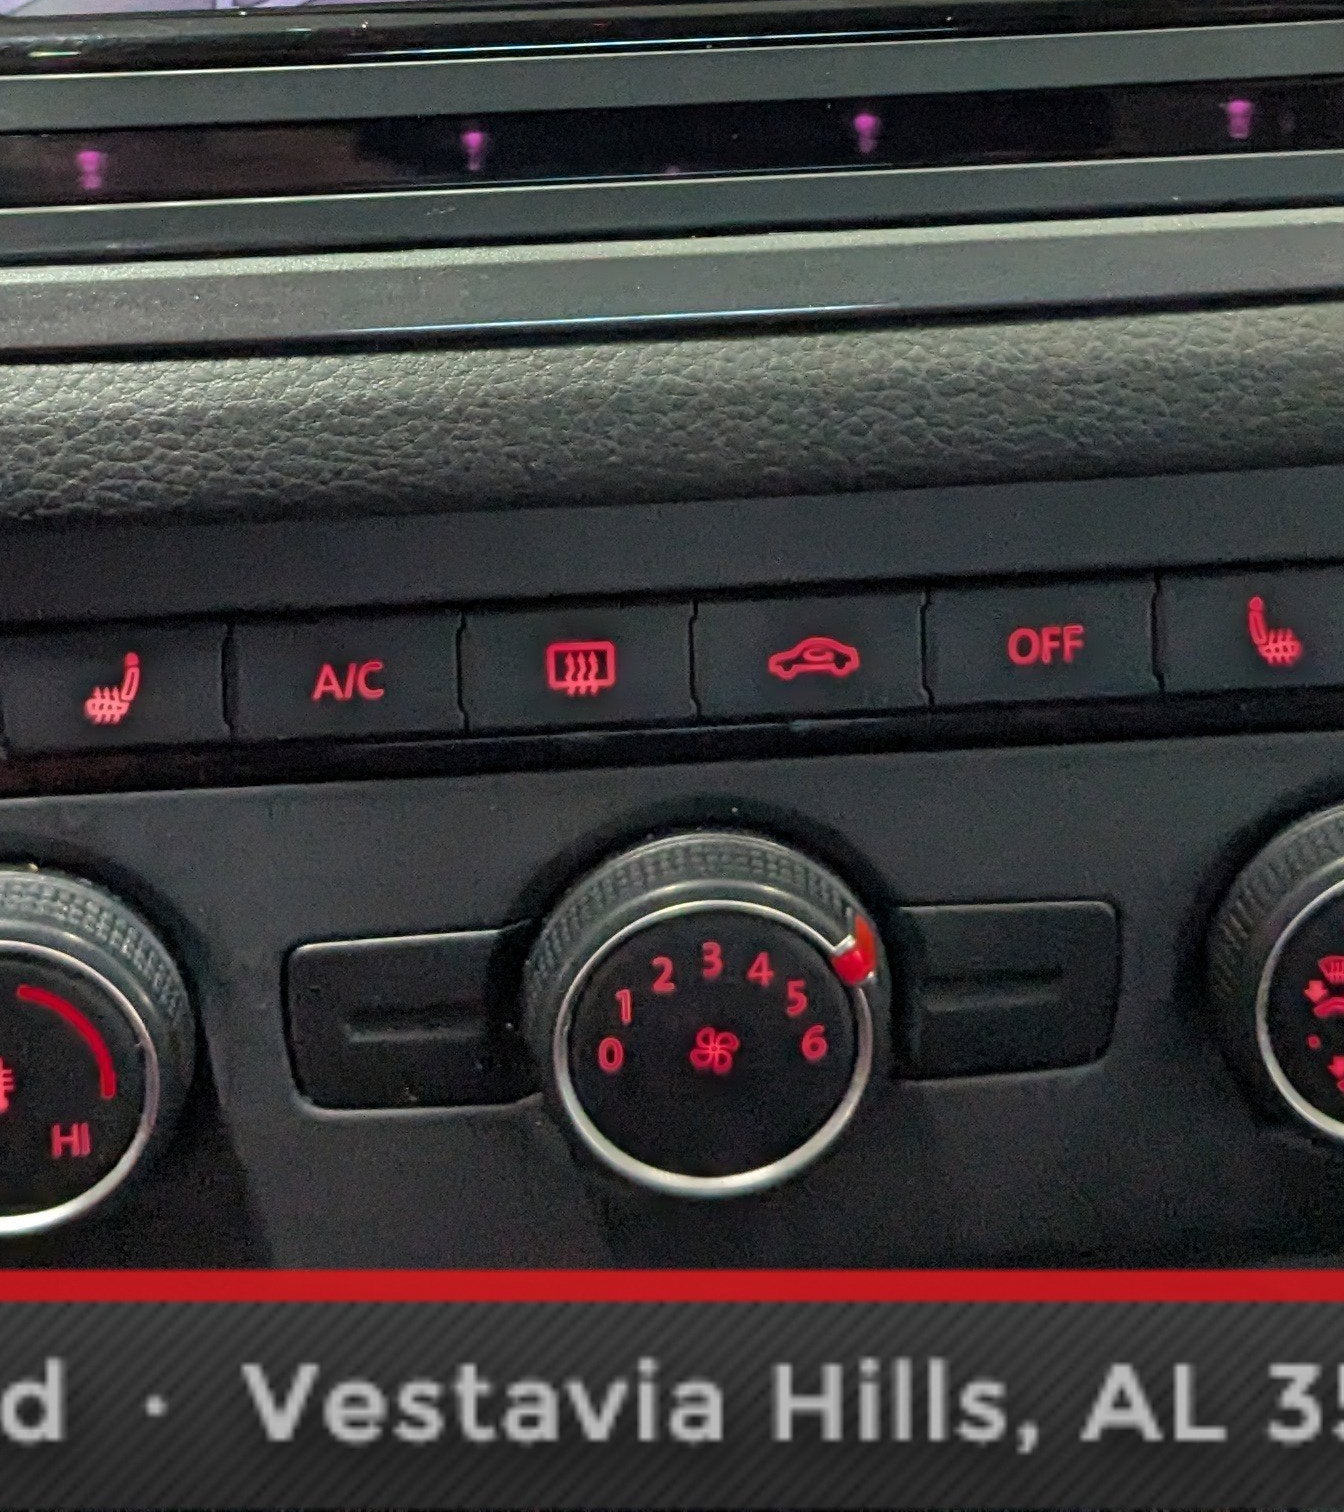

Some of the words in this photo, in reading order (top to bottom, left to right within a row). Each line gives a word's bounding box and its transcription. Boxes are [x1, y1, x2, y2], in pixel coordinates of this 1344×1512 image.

[1007, 624, 1085, 666] OFF
[312, 660, 385, 702] A/C
[652, 956, 676, 993] 2
[702, 941, 724, 979] 3
[748, 952, 773, 986] 4
[616, 989, 632, 1024] 1
[785, 980, 808, 1017] 5
[598, 1037, 624, 1072] 0
[802, 1025, 827, 1060] 6
[50, 1123, 92, 1158] HI
